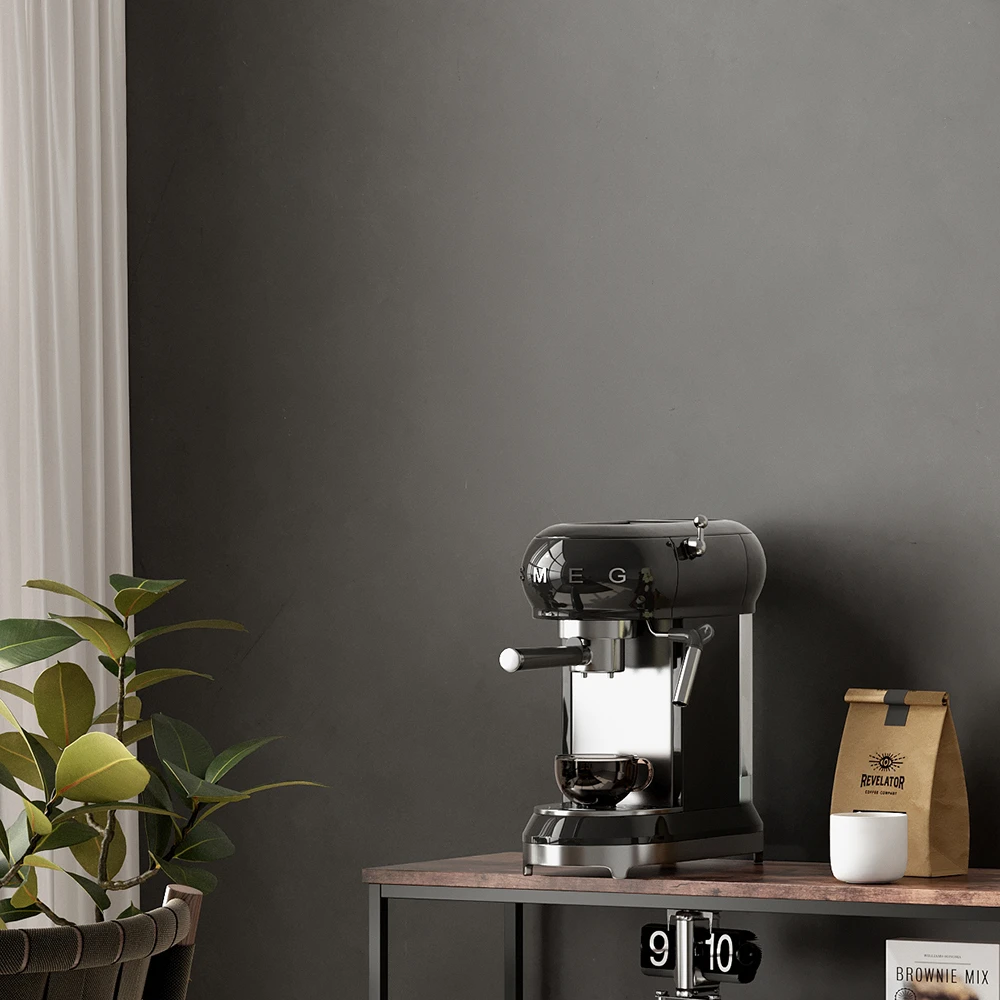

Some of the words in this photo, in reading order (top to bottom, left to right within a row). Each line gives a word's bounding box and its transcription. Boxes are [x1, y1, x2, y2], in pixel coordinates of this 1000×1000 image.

[860, 773, 905, 790] REVELATOR
[649, 930, 669, 967] 9
[705, 932, 734, 973] 10
[896, 966, 958, 984] BROWNIE
[965, 969, 989, 985] MIX
